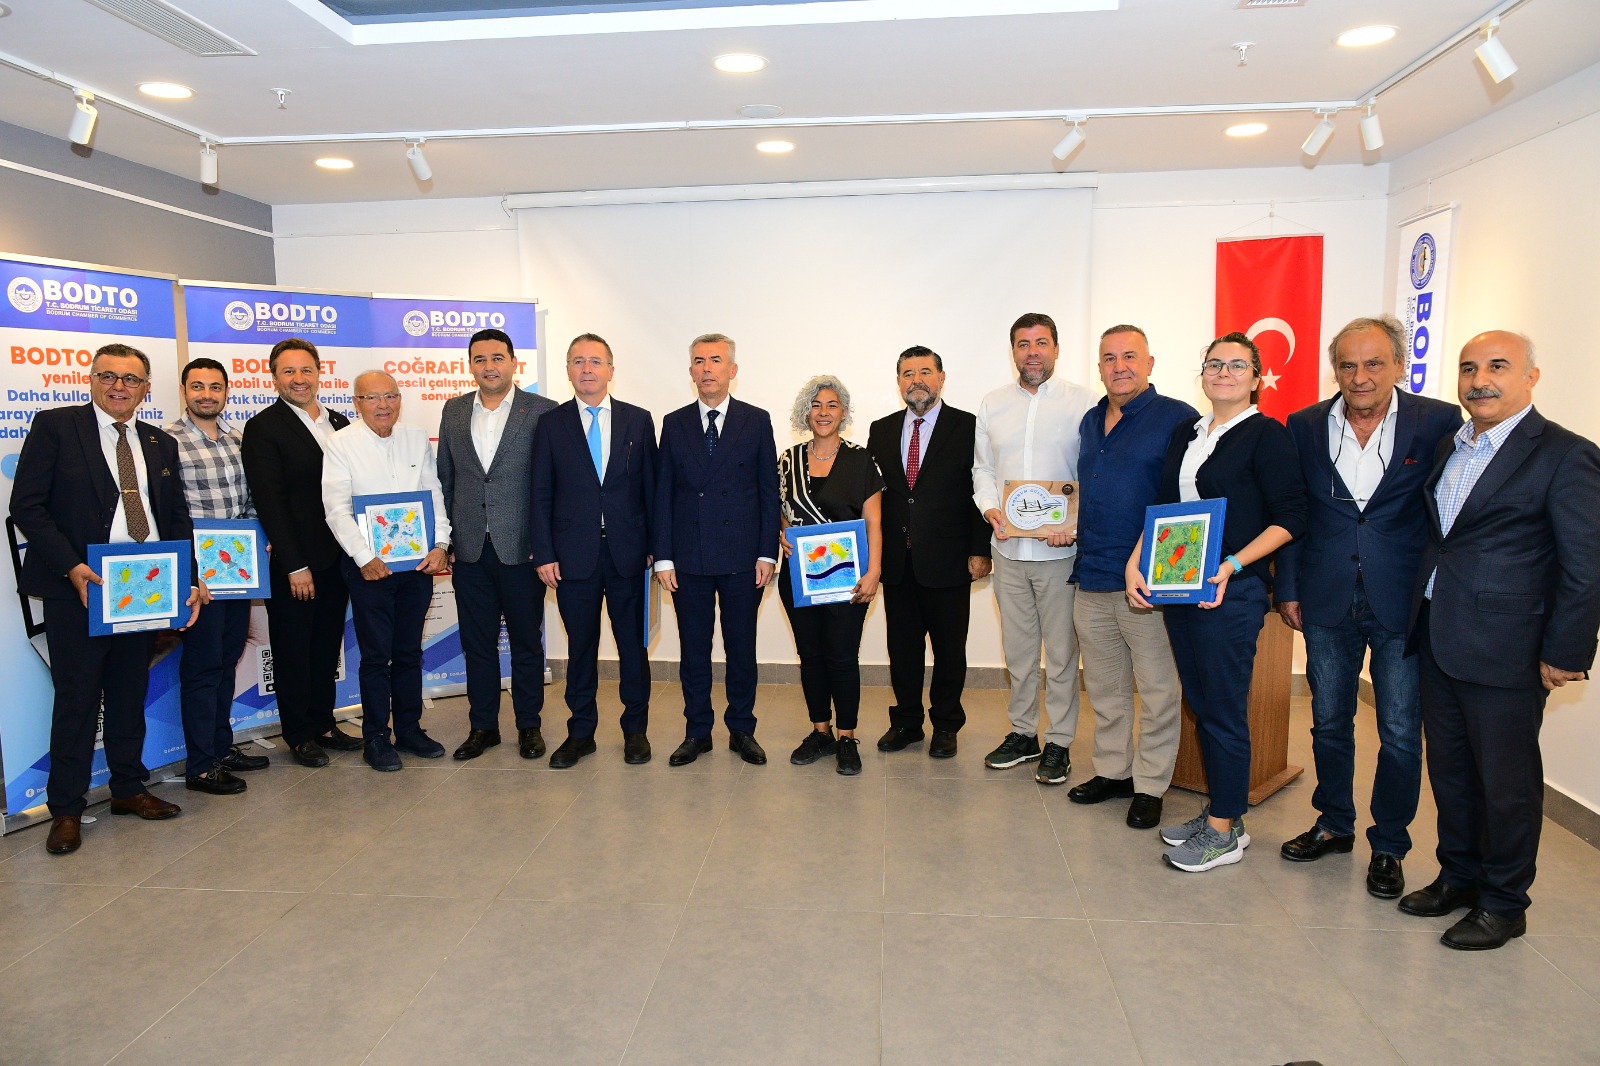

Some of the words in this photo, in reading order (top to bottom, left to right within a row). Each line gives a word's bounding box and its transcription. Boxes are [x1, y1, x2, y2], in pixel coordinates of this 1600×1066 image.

[43, 279, 138, 308] BODTO
[60, 302, 90, 311] BODRUM
[91, 304, 118, 313] TİCARET
[71, 311, 99, 319] CHAMBER
[254, 302, 338, 323] BODTO
[429, 311, 506, 328] BODTO
[1410, 291, 1433, 394] BOD
[383, 356, 465, 375] COĞRAFİ
[41, 371, 90, 388] yenile
[334, 378, 350, 389] ile
[396, 377, 426, 388] escil
[7, 389, 50, 402] Daha
[53, 391, 91, 402] kulla
[226, 394, 250, 405] rtık
